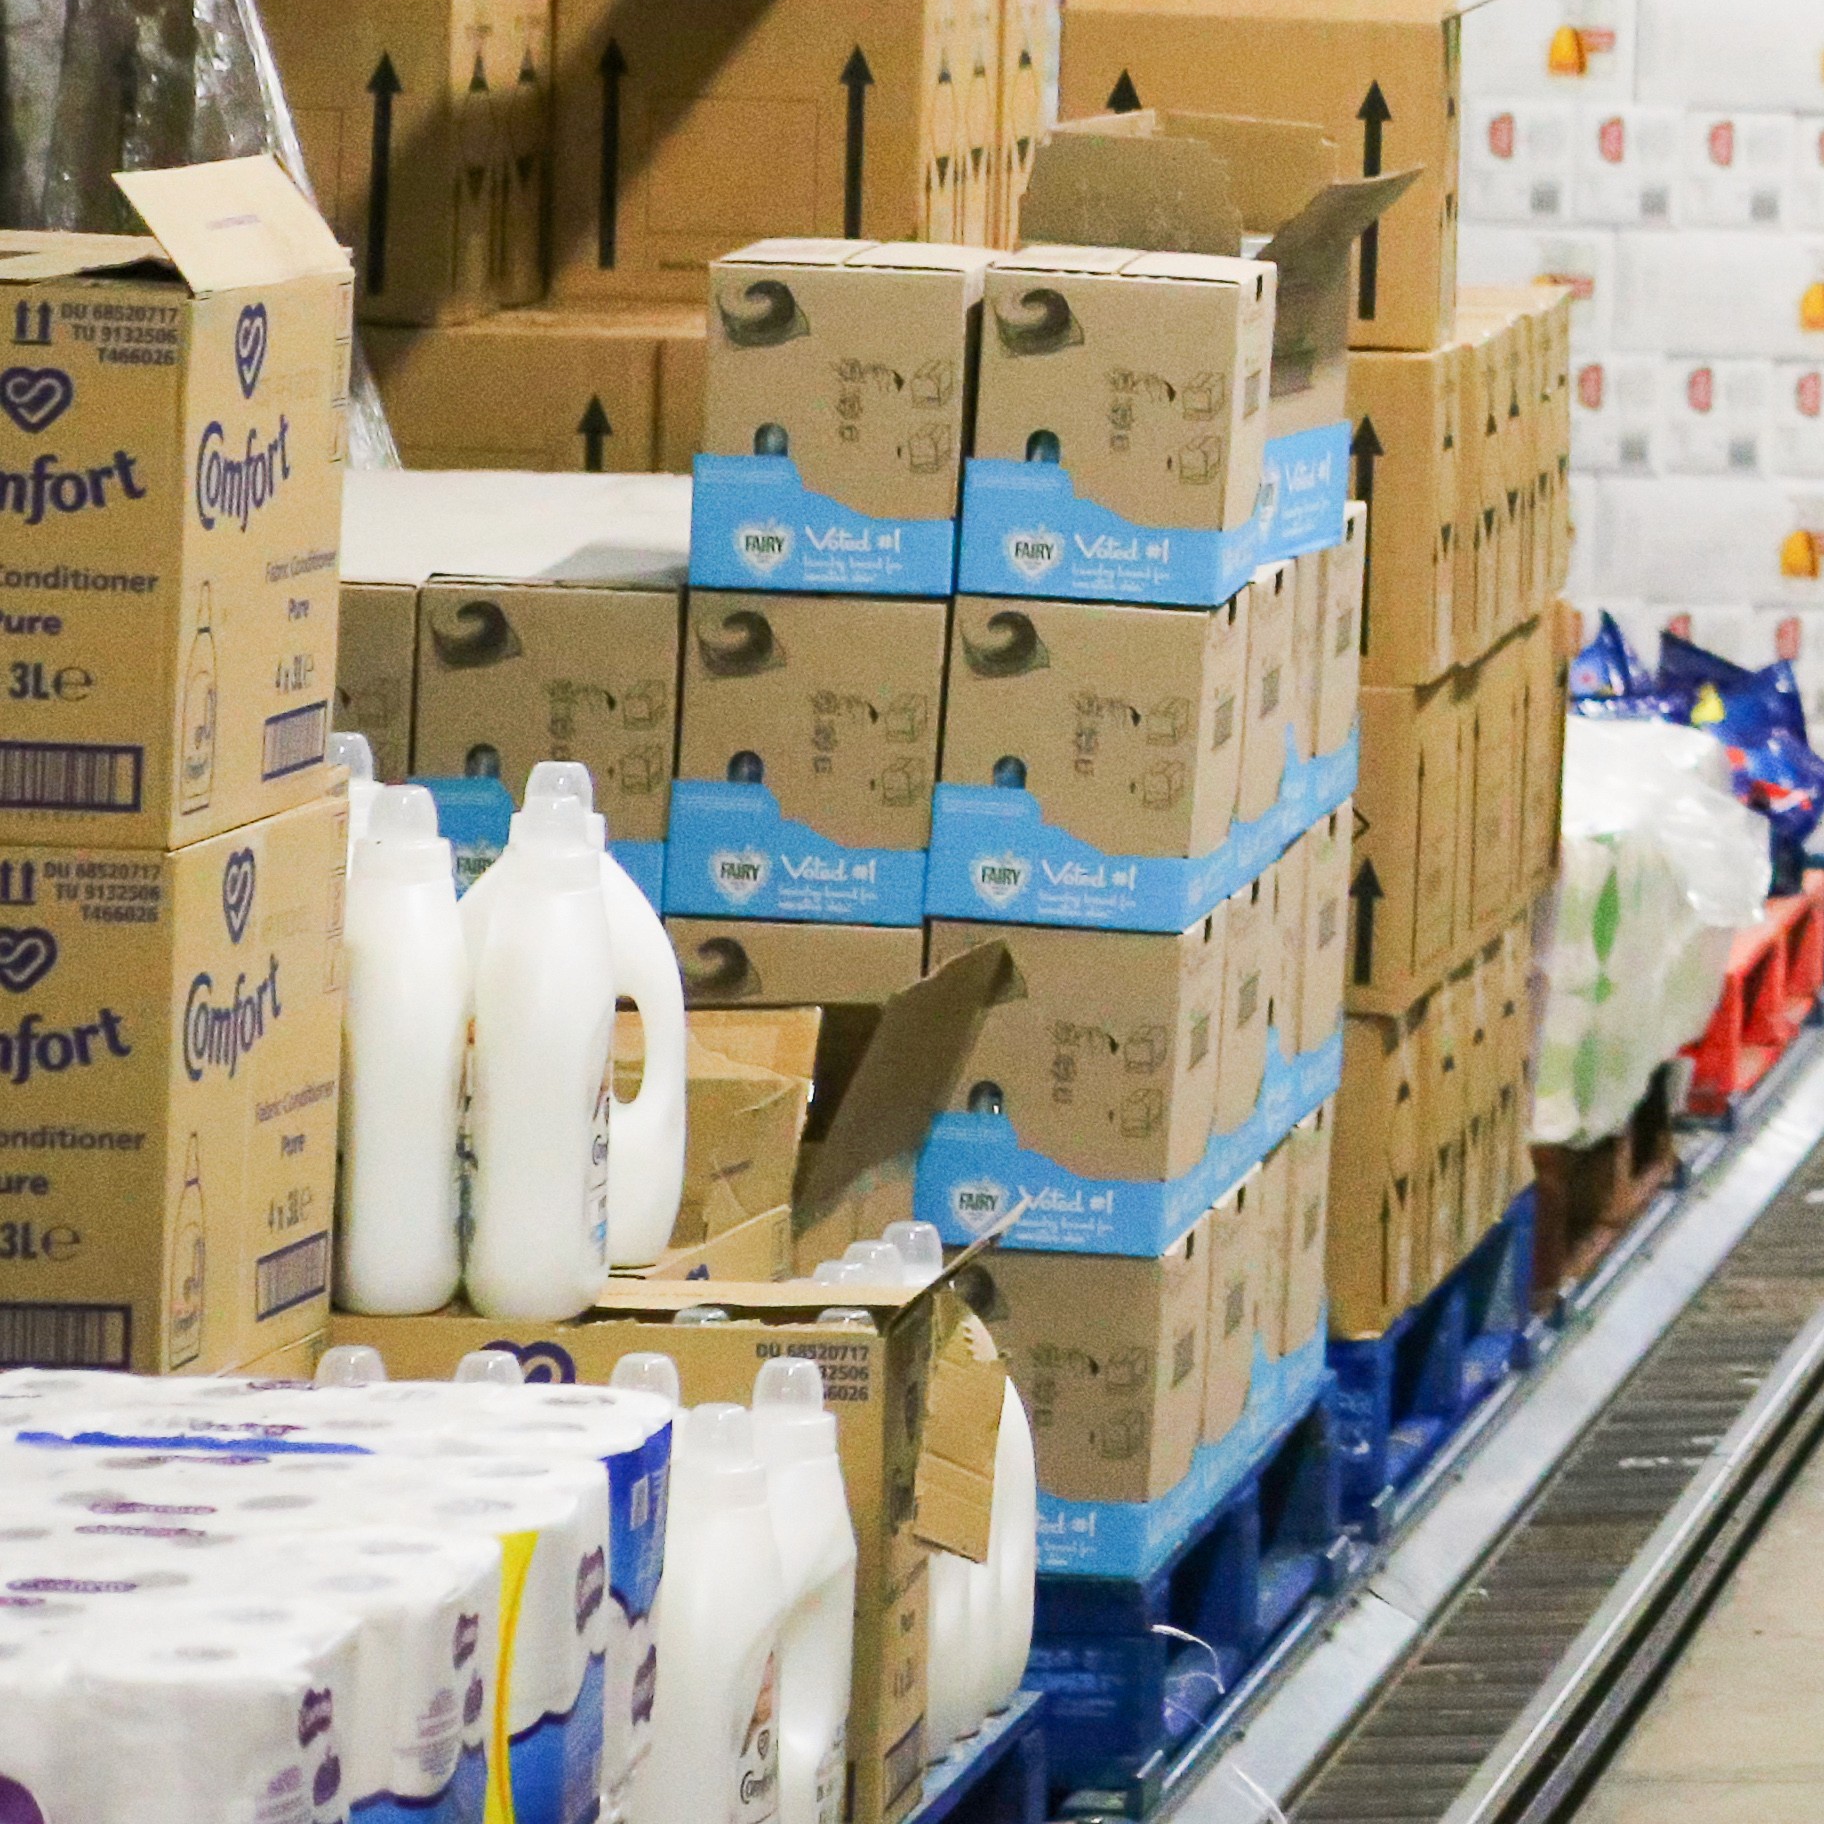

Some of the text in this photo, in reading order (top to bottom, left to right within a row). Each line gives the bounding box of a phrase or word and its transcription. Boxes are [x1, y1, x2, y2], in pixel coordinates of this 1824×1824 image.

[72, 324, 95, 341] TU
[196, 414, 290, 533] Comfort
[745, 535, 785, 554] FAIRY
[805, 525, 872, 553] Voted
[1014, 541, 1054, 560] FAIRY
[1074, 533, 1138, 561] Voted
[0, 563, 159, 594] onditioner
[720, 861, 760, 881] FAIRY
[780, 853, 847, 882] Voted
[982, 865, 1021, 886] FAIRY
[1042, 859, 1107, 889] Voted
[183, 952, 282, 1082] Comfort
[959, 1191, 999, 1212] FAIRY
[1018, 1184, 1084, 1213] Voted
[756, 1343, 781, 1358] DU
